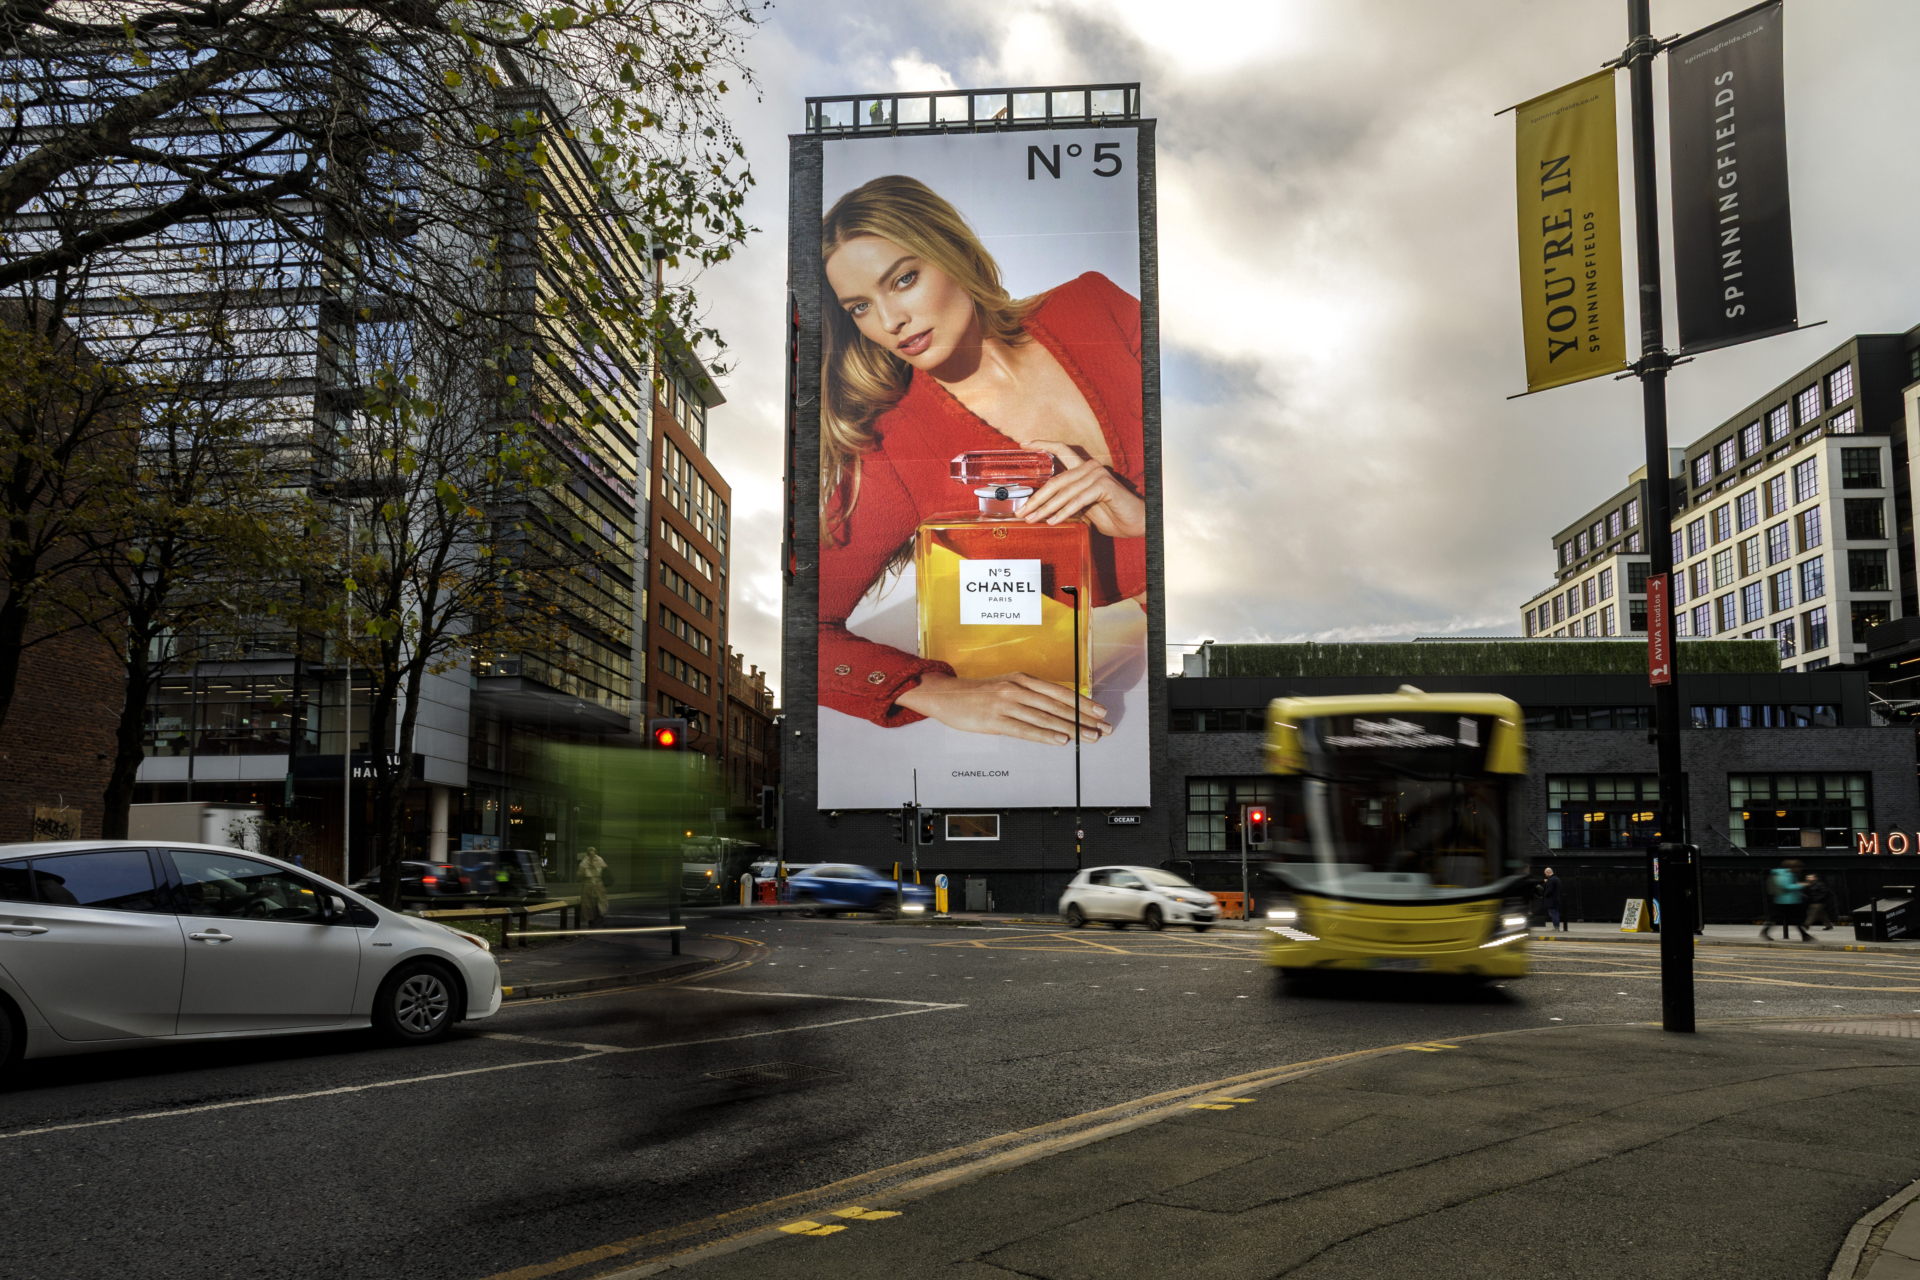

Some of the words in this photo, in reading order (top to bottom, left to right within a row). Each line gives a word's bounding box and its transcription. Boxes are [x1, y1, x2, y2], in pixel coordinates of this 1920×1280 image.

[1684, 25, 1764, 65] spinningfields.co.uk
[1530, 94, 1599, 124] spinningfields.co.uk
[1540, 154, 1572, 202] IN
[1714, 70, 1746, 319] SPINNINGFIELDS
[1542, 207, 1579, 364] YOU'RE
[1583, 211, 1601, 353] SPINNINGFIELDS
[966, 581, 1036, 593] CHANEL
[1653, 593, 1662, 628] studios
[1654, 629, 1663, 661] AVIVA
[951, 770, 1010, 778] CHANEL.COM
[1857, 832, 1920, 855] MO
